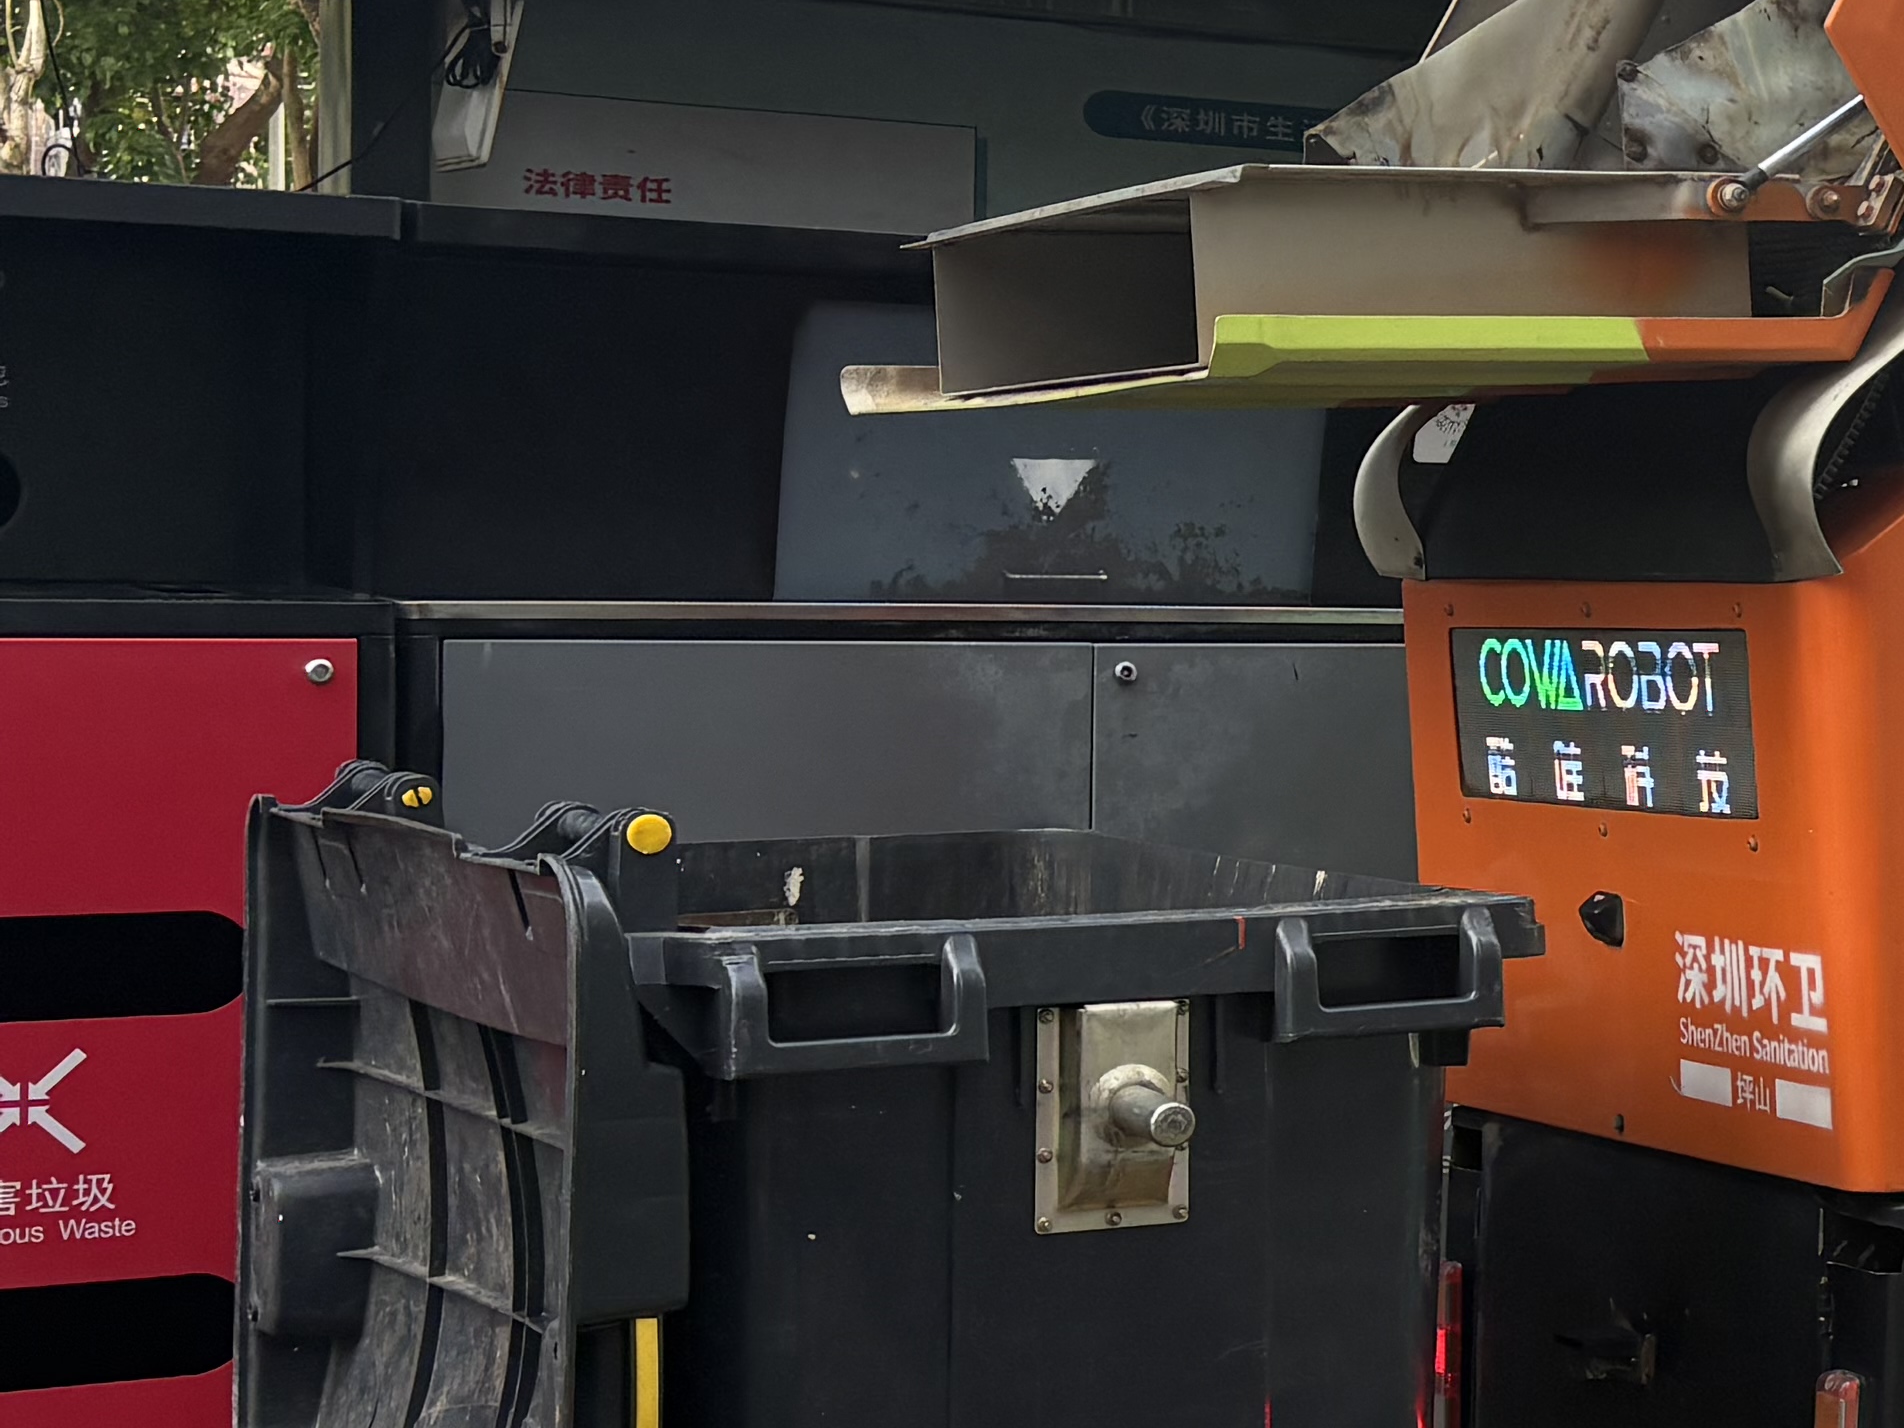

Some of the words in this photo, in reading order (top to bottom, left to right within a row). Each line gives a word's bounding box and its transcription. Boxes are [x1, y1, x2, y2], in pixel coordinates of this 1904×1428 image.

[1141, 105, 1318, 142] 《深圳市生
[523, 168, 672, 204] 法律责任
[1479, 637, 1720, 716] COWAROBOT
[1485, 735, 1732, 815] 酷哇科技
[1674, 930, 1829, 1035] 深圳环卫
[1679, 1016, 1751, 1059] ShenZhen
[1752, 1029, 1830, 1075] Sanitation
[1736, 1071, 1771, 1115] 坪山
[58, 1216, 137, 1241] Waste
